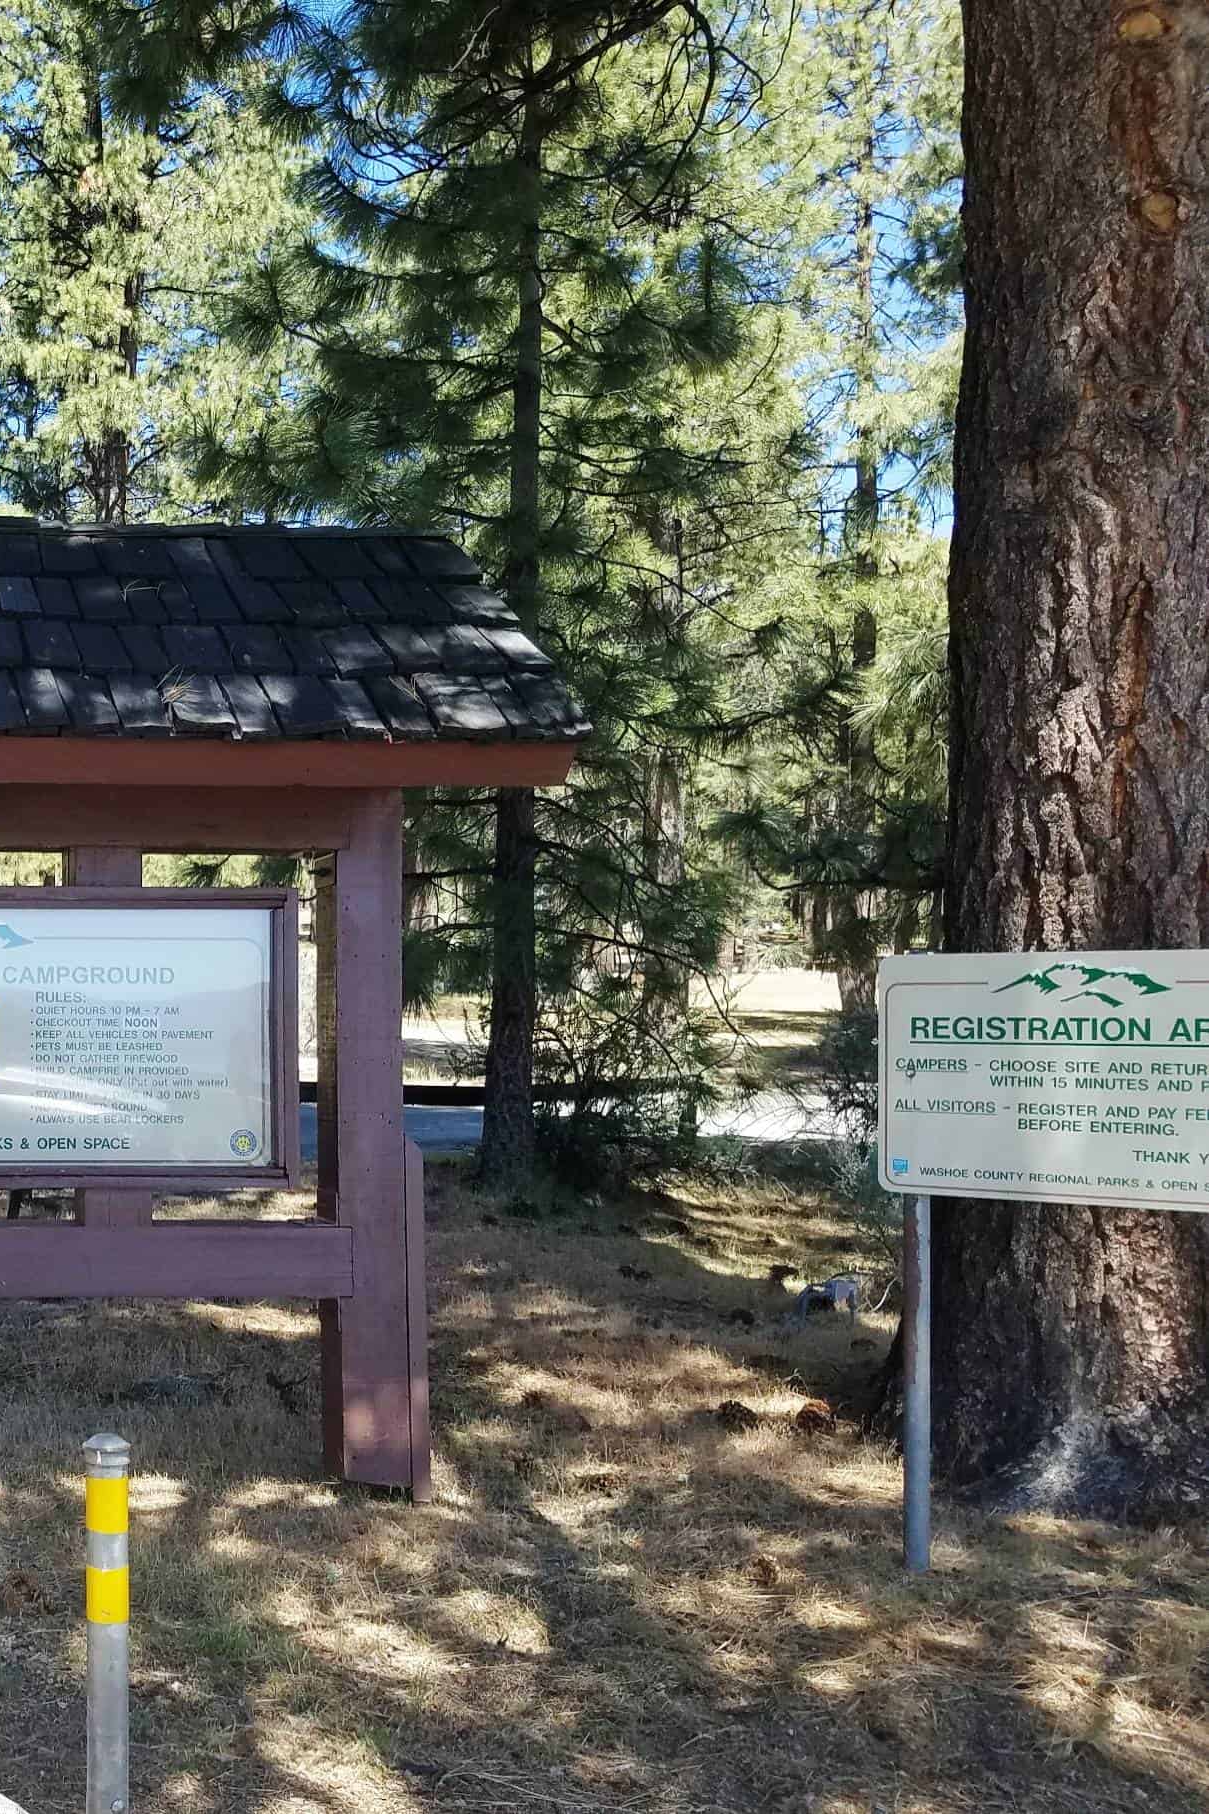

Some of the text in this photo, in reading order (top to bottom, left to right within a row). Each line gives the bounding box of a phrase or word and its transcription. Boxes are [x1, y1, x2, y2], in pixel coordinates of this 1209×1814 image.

[3, 967, 175, 985] CAMPGROUND
[35, 991, 86, 1003] RULES:
[35, 1006, 66, 1015] QUIET
[70, 1006, 106, 1015] HOURS
[125, 1006, 140, 1015] PM
[164, 1007, 180, 1015] AM
[35, 1017, 158, 1028] CHECKOUT TIME NOON
[910, 1016, 1151, 1041] REGISTRATION
[35, 1030, 214, 1039] KEEP ALL VEHICLES ON PAVEMENT
[35, 1042, 163, 1051] PETS MUST BE LEASHED
[35, 1054, 178, 1063] DO NOT GATHER FIREWOOD
[69, 1066, 119, 1075] CAMPFIRE
[124, 1066, 135, 1075] IN
[139, 1066, 190, 1075] PROVIDED
[895, 1057, 967, 1071] CAMPERS
[989, 1059, 1057, 1073] CHOOSE
[1065, 1061, 1100, 1073] SITE
[1108, 1062, 1143, 1075] AND
[152, 1078, 168, 1087] out
[172, 1077, 192, 1087] with
[197, 1077, 229, 1088] water)
[989, 1075, 1044, 1088] WITHIN
[1051, 1077, 1068, 1089] 15
[1075, 1078, 1149, 1091] MINUTES
[1157, 1079, 1192, 1092] AND
[174, 1090, 200, 1100] DAYS
[894, 1098, 921, 1111] ALL
[927, 1099, 996, 1113] VISITORS
[1017, 1102, 1097, 1117] REGISTER
[1105, 1105, 1140, 1118] AND
[1148, 1107, 1177, 1119] PAY
[1185, 1108, 1209, 1121] FE
[35, 1115, 184, 1124] ALWAYS USE BEAR LOCKERS
[1017, 1118, 1179, 1136] BEFORE ENTERING.
[20, 1137, 30, 1150] &
[37, 1137, 77, 1150] OPEN
[83, 1137, 131, 1150] SPACE
[1132, 1150, 1191, 1164] THANK
[919, 1166, 969, 1178] WASHOE
[973, 1169, 1024, 1180] COUNTY
[1029, 1173, 1092, 1185] REGIONAL
[1097, 1176, 1140, 1188] PARKS
[1145, 1180, 1155, 1189] &
[1161, 1180, 1198, 1191] OPEN
